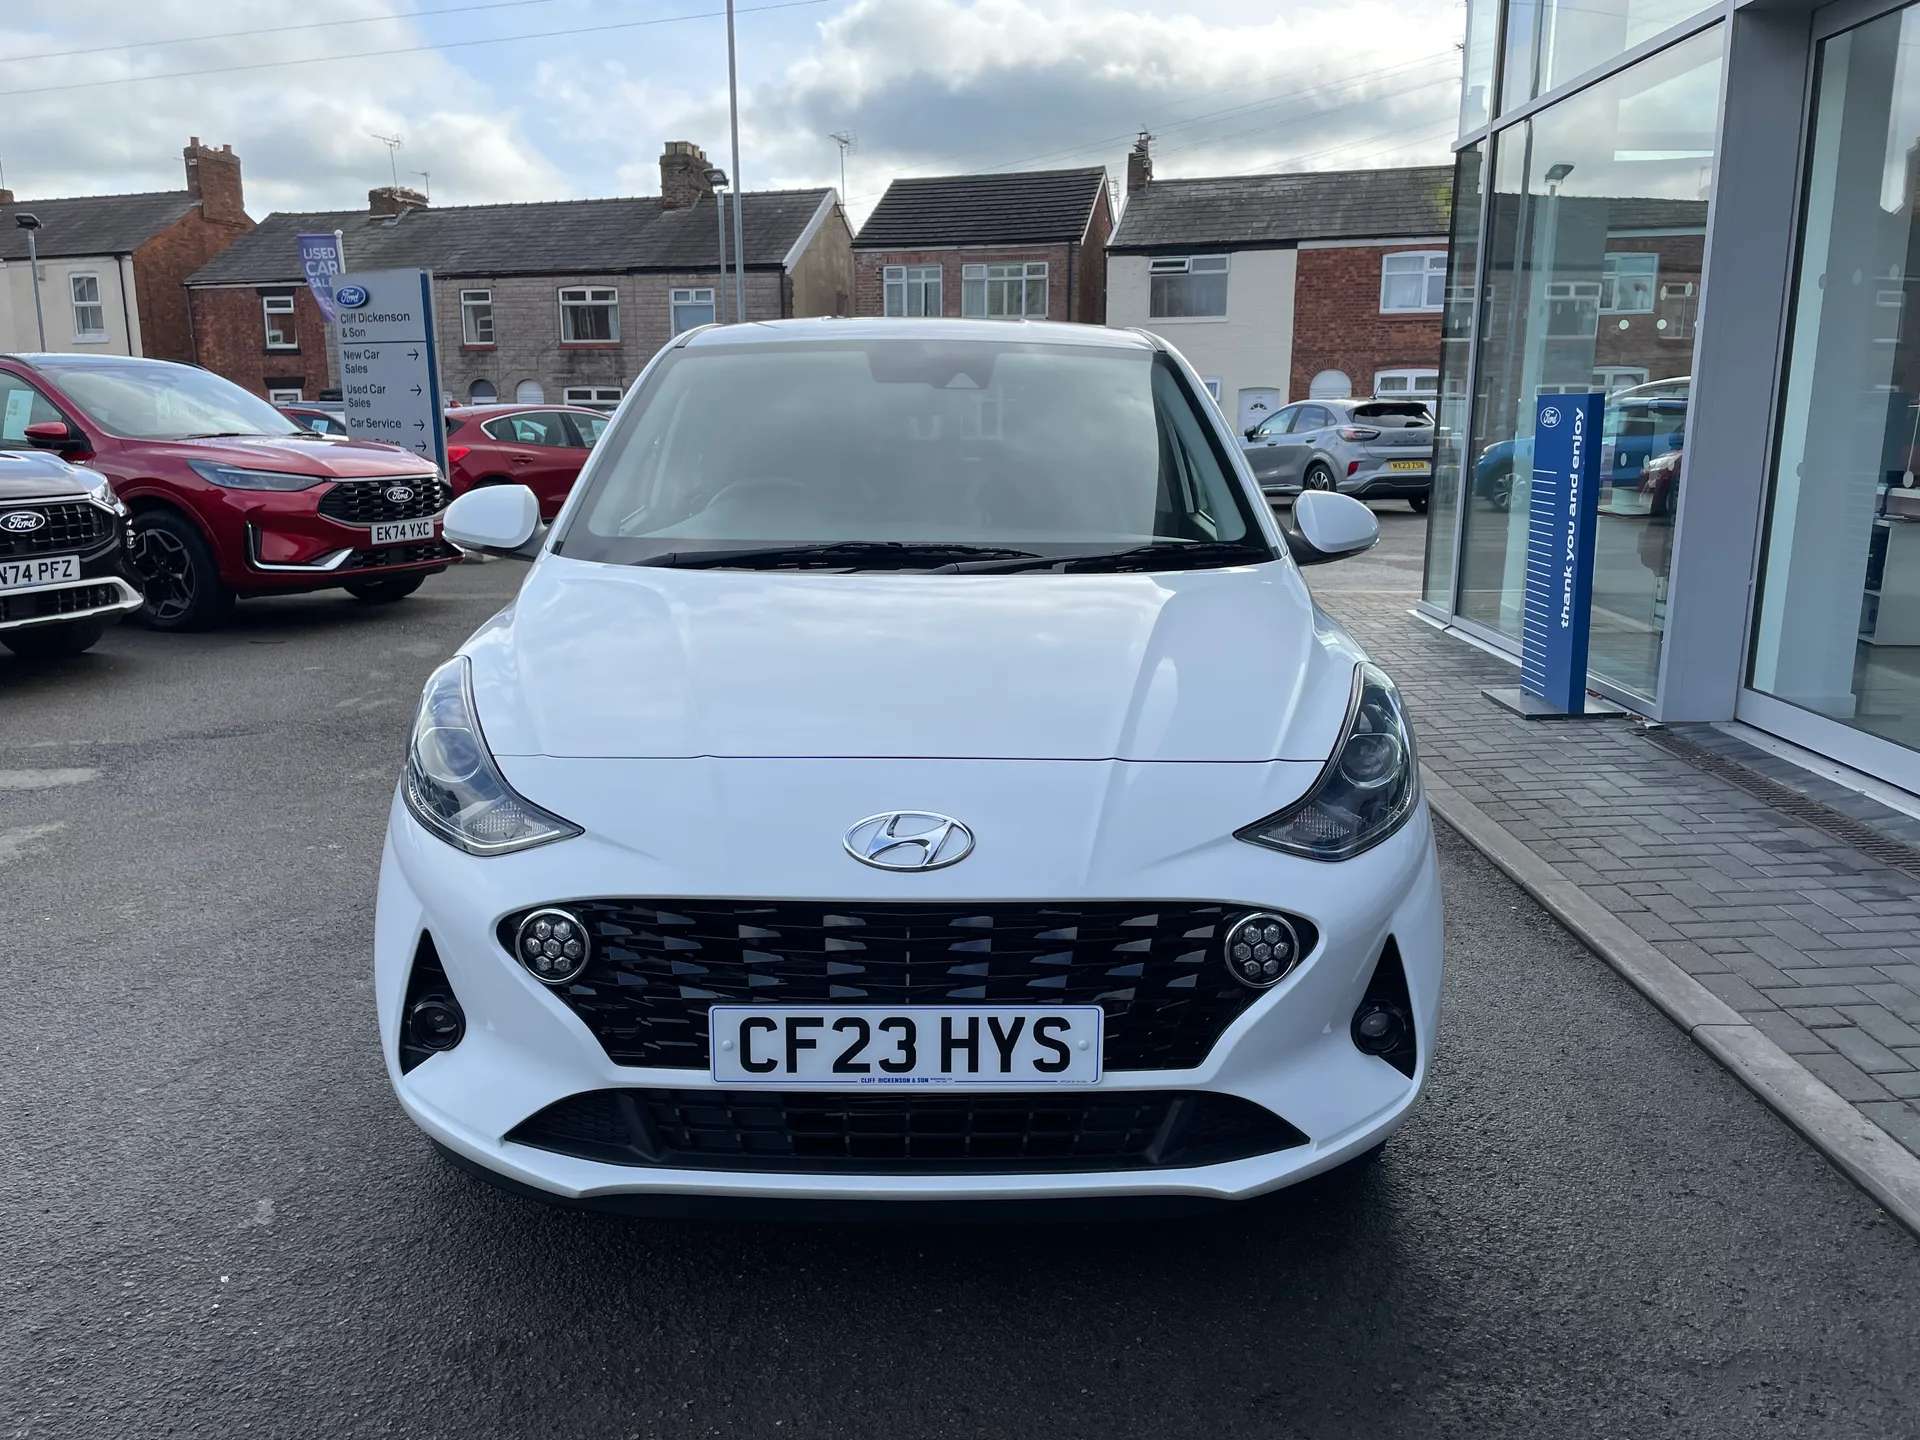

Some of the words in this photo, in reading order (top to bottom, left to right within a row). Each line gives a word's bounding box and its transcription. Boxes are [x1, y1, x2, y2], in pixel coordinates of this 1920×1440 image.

[303, 247, 336, 259] USED
[306, 260, 339, 275] CAR
[341, 288, 360, 304] Ford
[340, 312, 356, 324] Cliff
[358, 311, 410, 323] Dickenson
[342, 327, 348, 338] &
[349, 327, 366, 338] Son
[343, 349, 362, 360] New
[363, 349, 380, 360] Car
[345, 363, 369, 374] Sales
[346, 383, 368, 394] Used
[369, 383, 387, 394] Car
[348, 397, 372, 408] Sales
[350, 417, 364, 428] Car
[366, 417, 402, 429] Service
[1543, 409, 1558, 424] Ford
[1572, 407, 1584, 469] enjoy
[392, 489, 409, 500] Ford
[1569, 474, 1579, 517] and
[8, 514, 37, 529] Ford
[377, 524, 406, 541] EK74
[409, 521, 430, 538] YXC
[1566, 520, 1576, 561] you
[38, 559, 73, 581] PFZ
[1561, 565, 1573, 629] thank
[739, 1016, 917, 1073] CF23
[940, 1016, 1071, 1073] HYS
